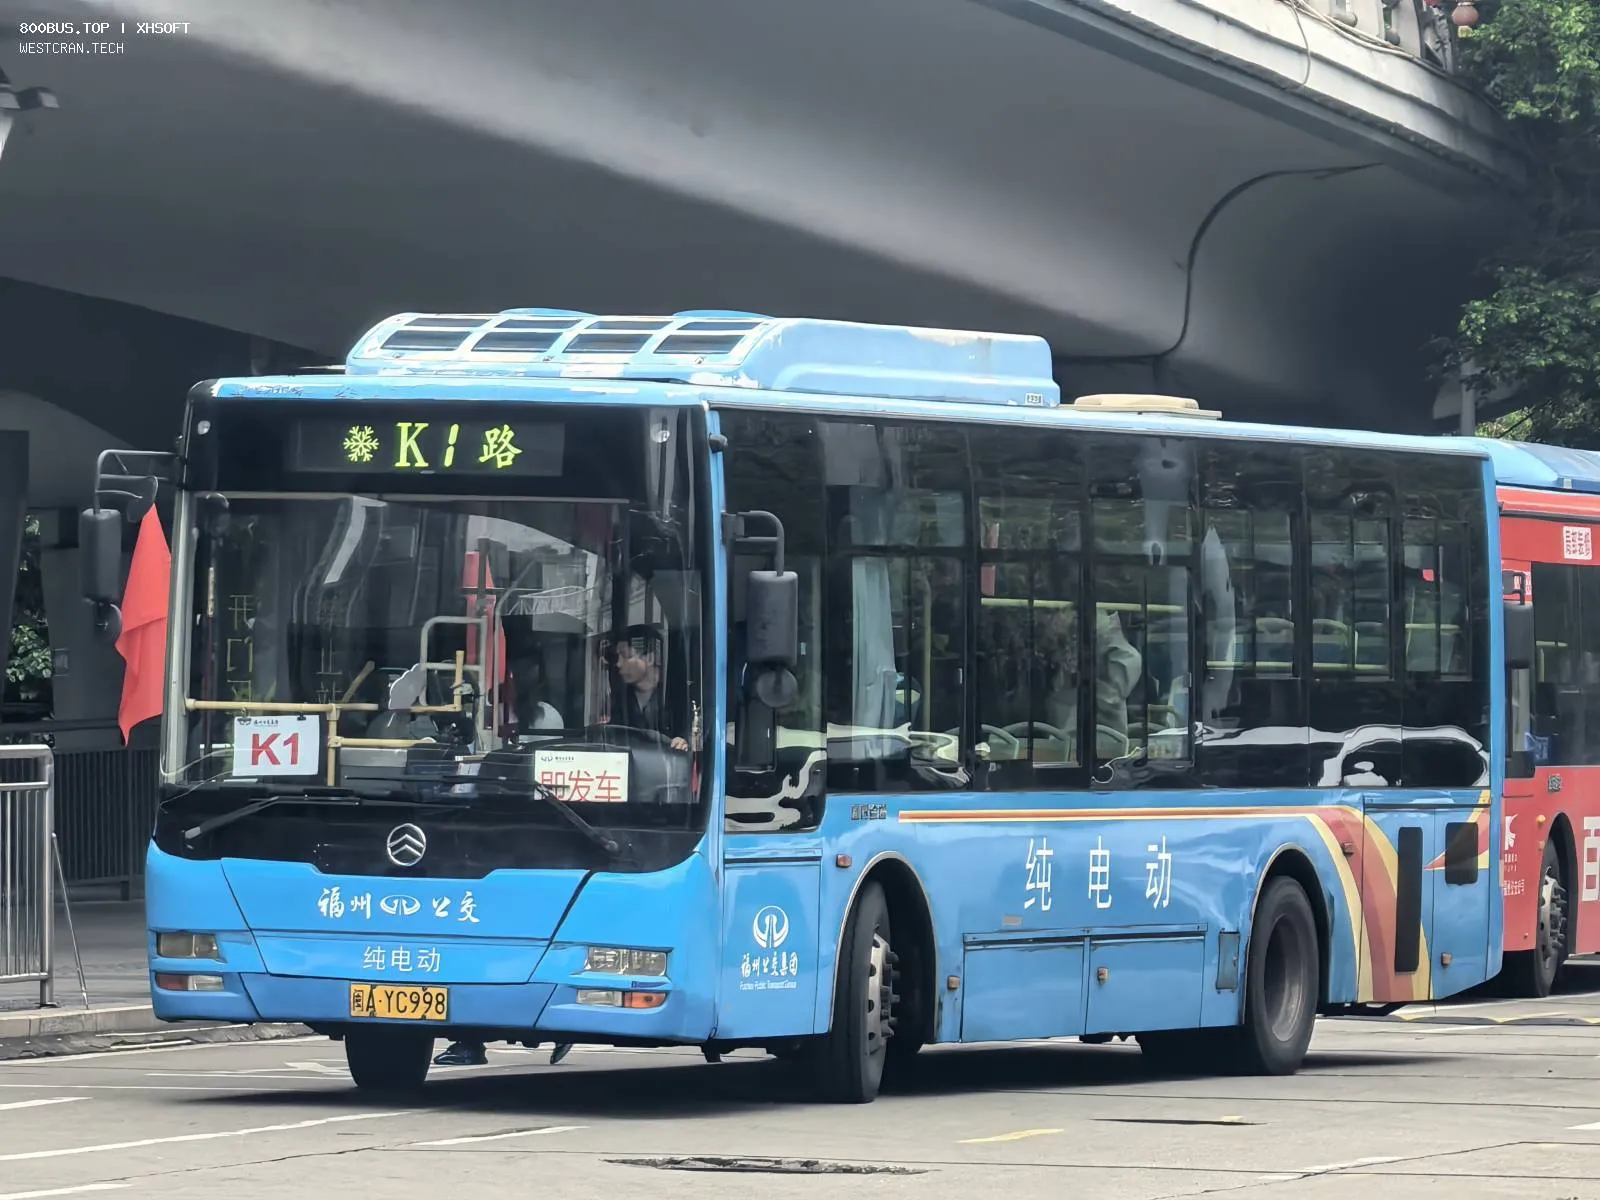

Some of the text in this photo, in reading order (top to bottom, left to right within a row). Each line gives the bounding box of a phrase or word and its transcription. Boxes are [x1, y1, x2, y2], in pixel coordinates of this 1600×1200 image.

[251, 732, 299, 766] K1
[1024, 835, 1172, 911] 纯电动
[317, 886, 481, 923] 福州 公交
[362, 945, 441, 973] 纯电动
